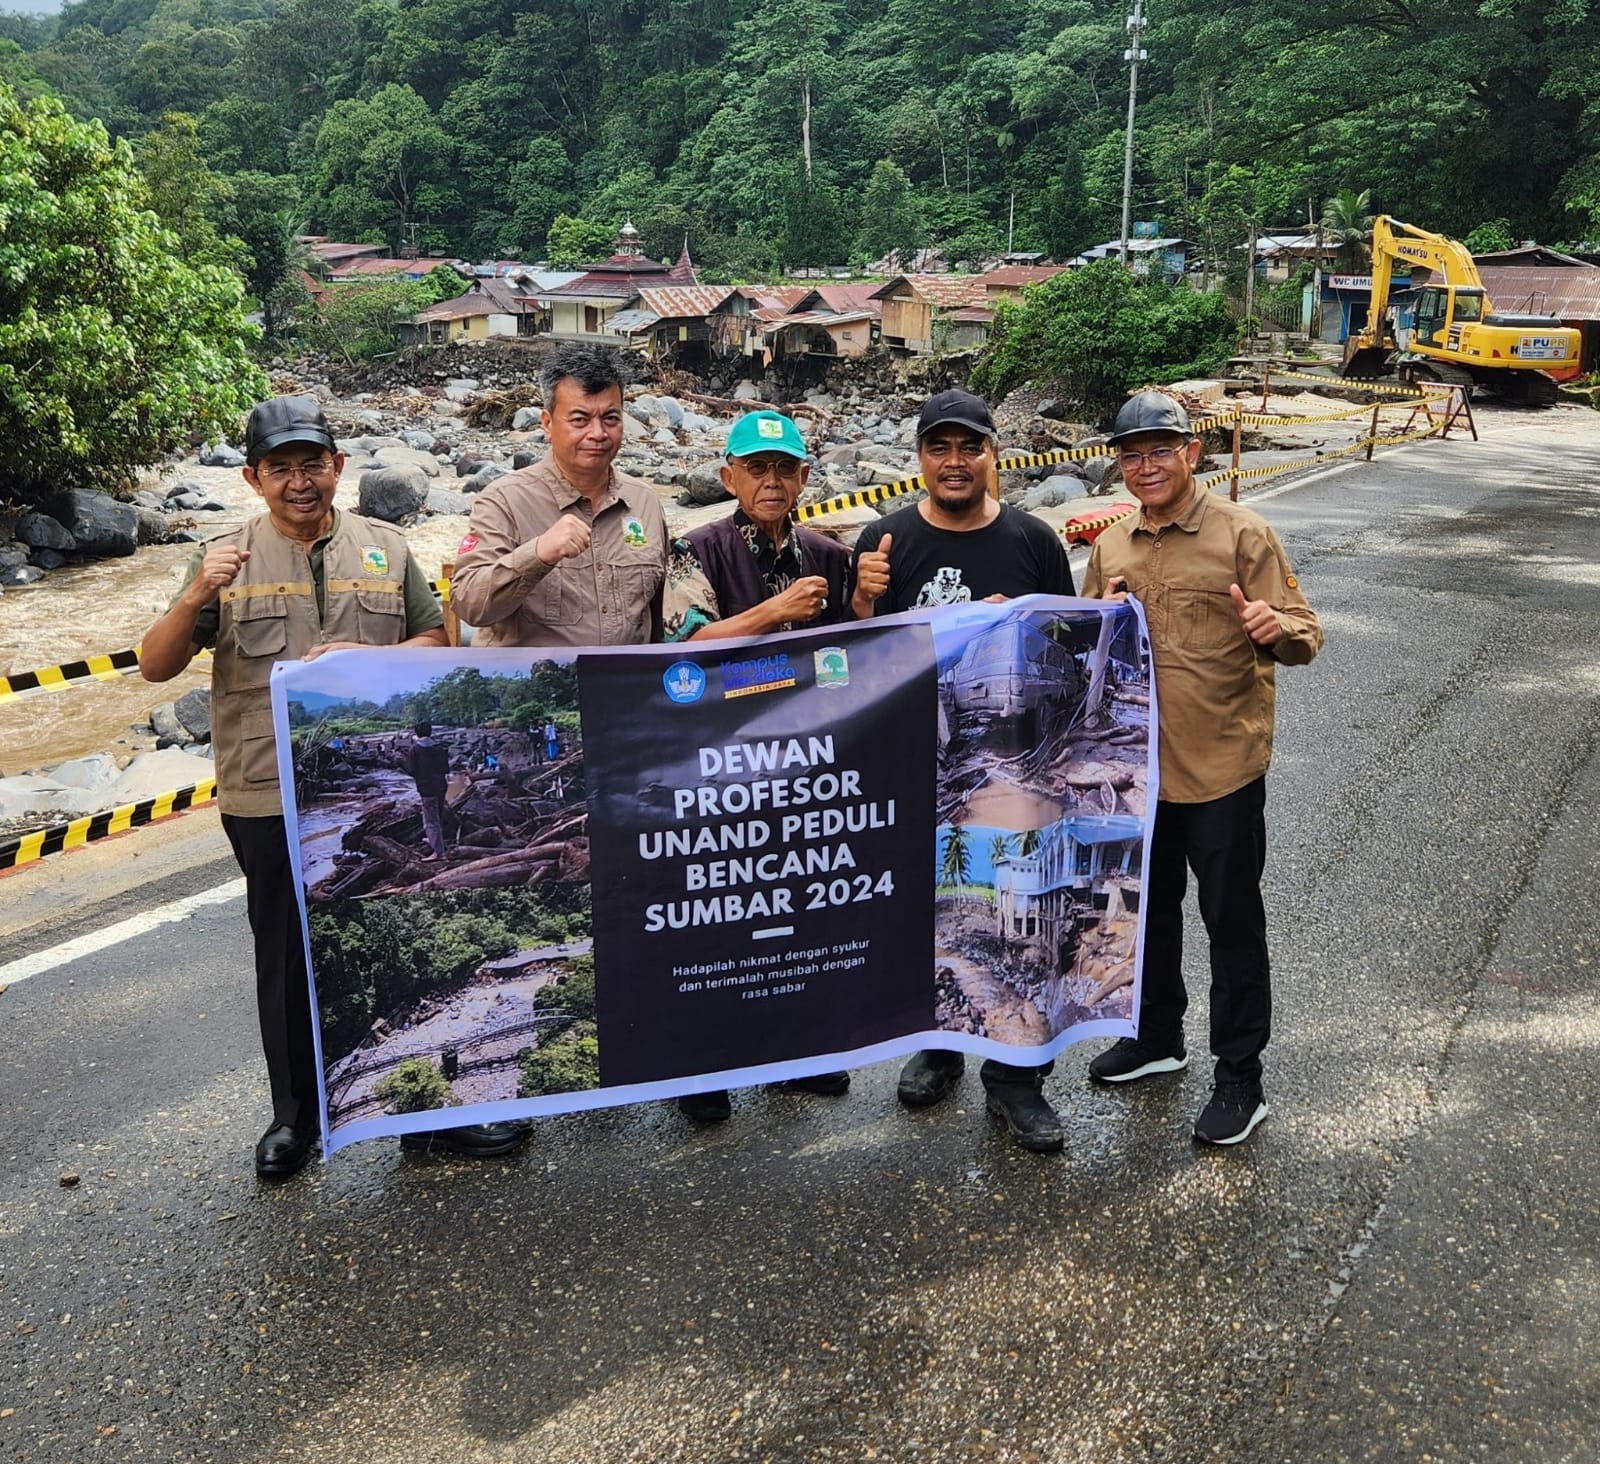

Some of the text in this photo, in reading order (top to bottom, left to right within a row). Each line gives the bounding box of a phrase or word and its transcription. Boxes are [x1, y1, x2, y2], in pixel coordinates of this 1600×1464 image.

[1397, 245, 1428, 259] KOMATSU
[1334, 277, 1373, 287] WC UMU
[1533, 338, 1565, 347] PUPR
[699, 735, 835, 777] DEWAN
[674, 770, 863, 819] PROFESOR
[639, 799, 895, 860] UNAND PEDULI
[686, 843, 856, 891] BENCANA
[644, 870, 894, 932] SUMBAR 2024
[672, 939, 870, 977] Hadapilah nikmat dengan syukur
[678, 956, 865, 993] dan terimalah musibah dengan
[742, 981, 806, 1000] rasa sabar
